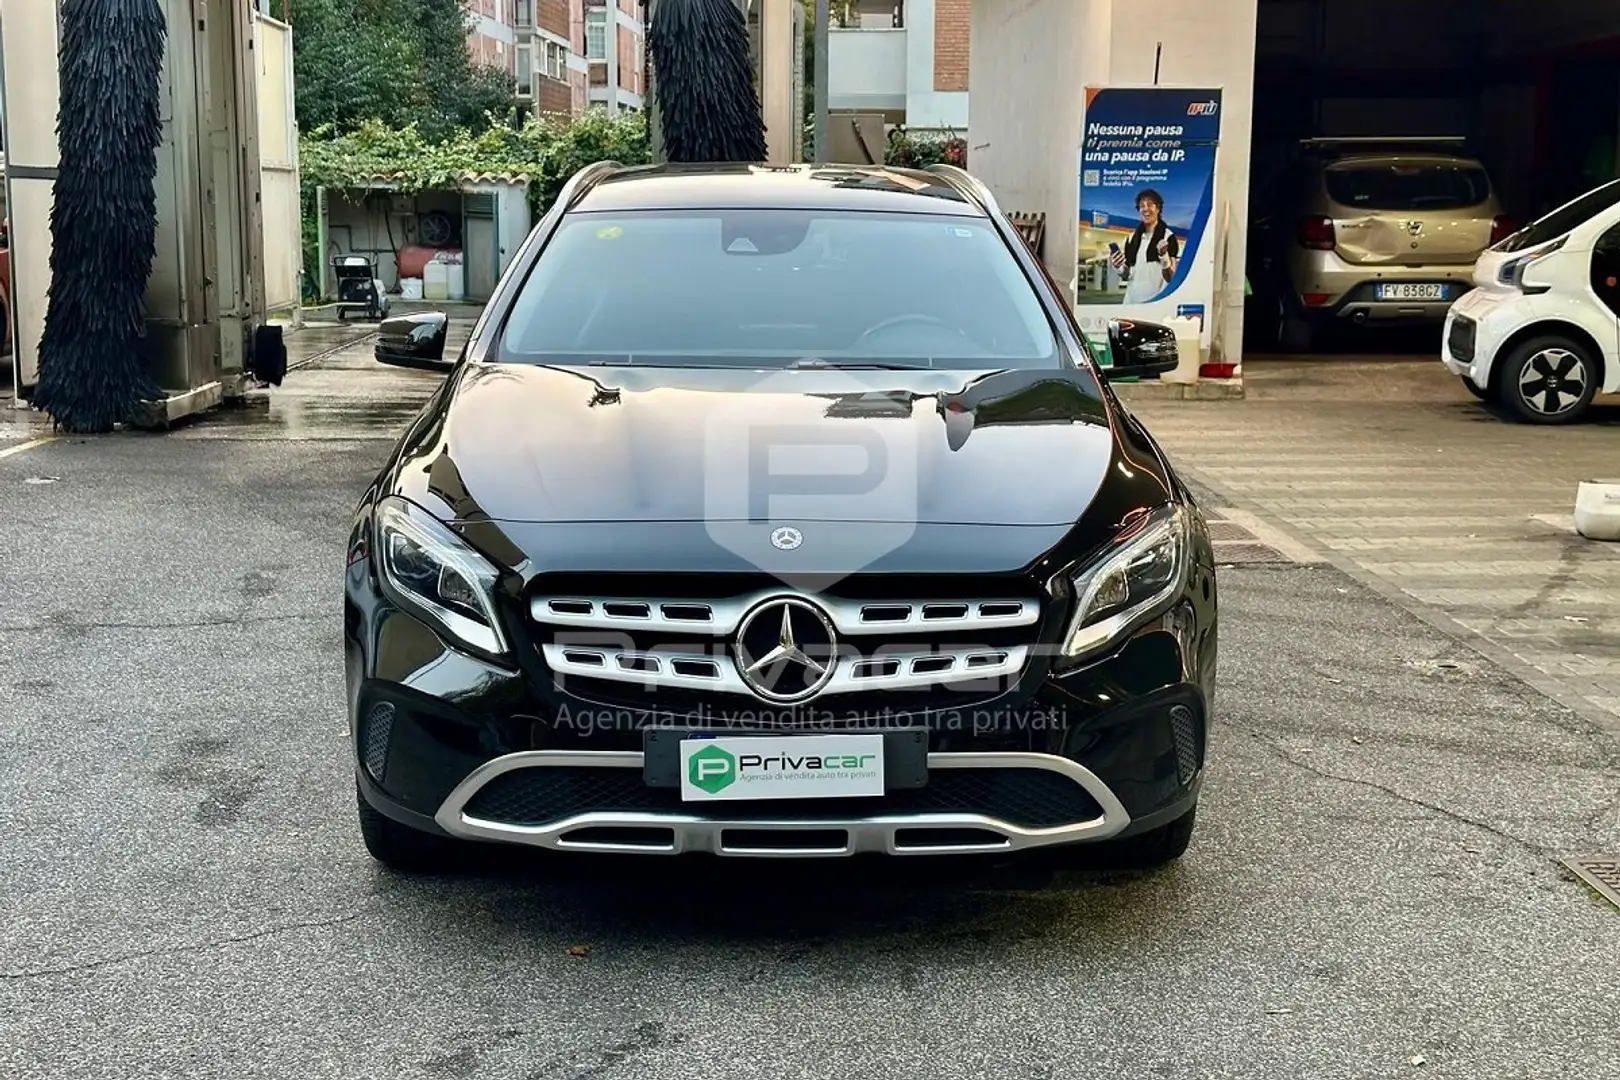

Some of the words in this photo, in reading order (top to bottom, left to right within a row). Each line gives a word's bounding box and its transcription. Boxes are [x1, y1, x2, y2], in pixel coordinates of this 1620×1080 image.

[1088, 123, 1143, 136] Nessuna
[1144, 126, 1184, 139] pausa
[1087, 137, 1098, 148] ti
[1097, 137, 1144, 151] premia
[1145, 140, 1181, 149] come
[1085, 152, 1109, 162] una
[1110, 152, 1150, 165] pausa
[1151, 149, 1169, 162] da
[1170, 149, 1185, 162] IP.
[739, 751, 876, 771] Privacar
[739, 772, 773, 782] Agenzia
[775, 770, 784, 780] di
[785, 769, 815, 779] vendita
[817, 770, 836, 779] auto
[838, 770, 849, 778] tra
[851, 770, 876, 780] privati
